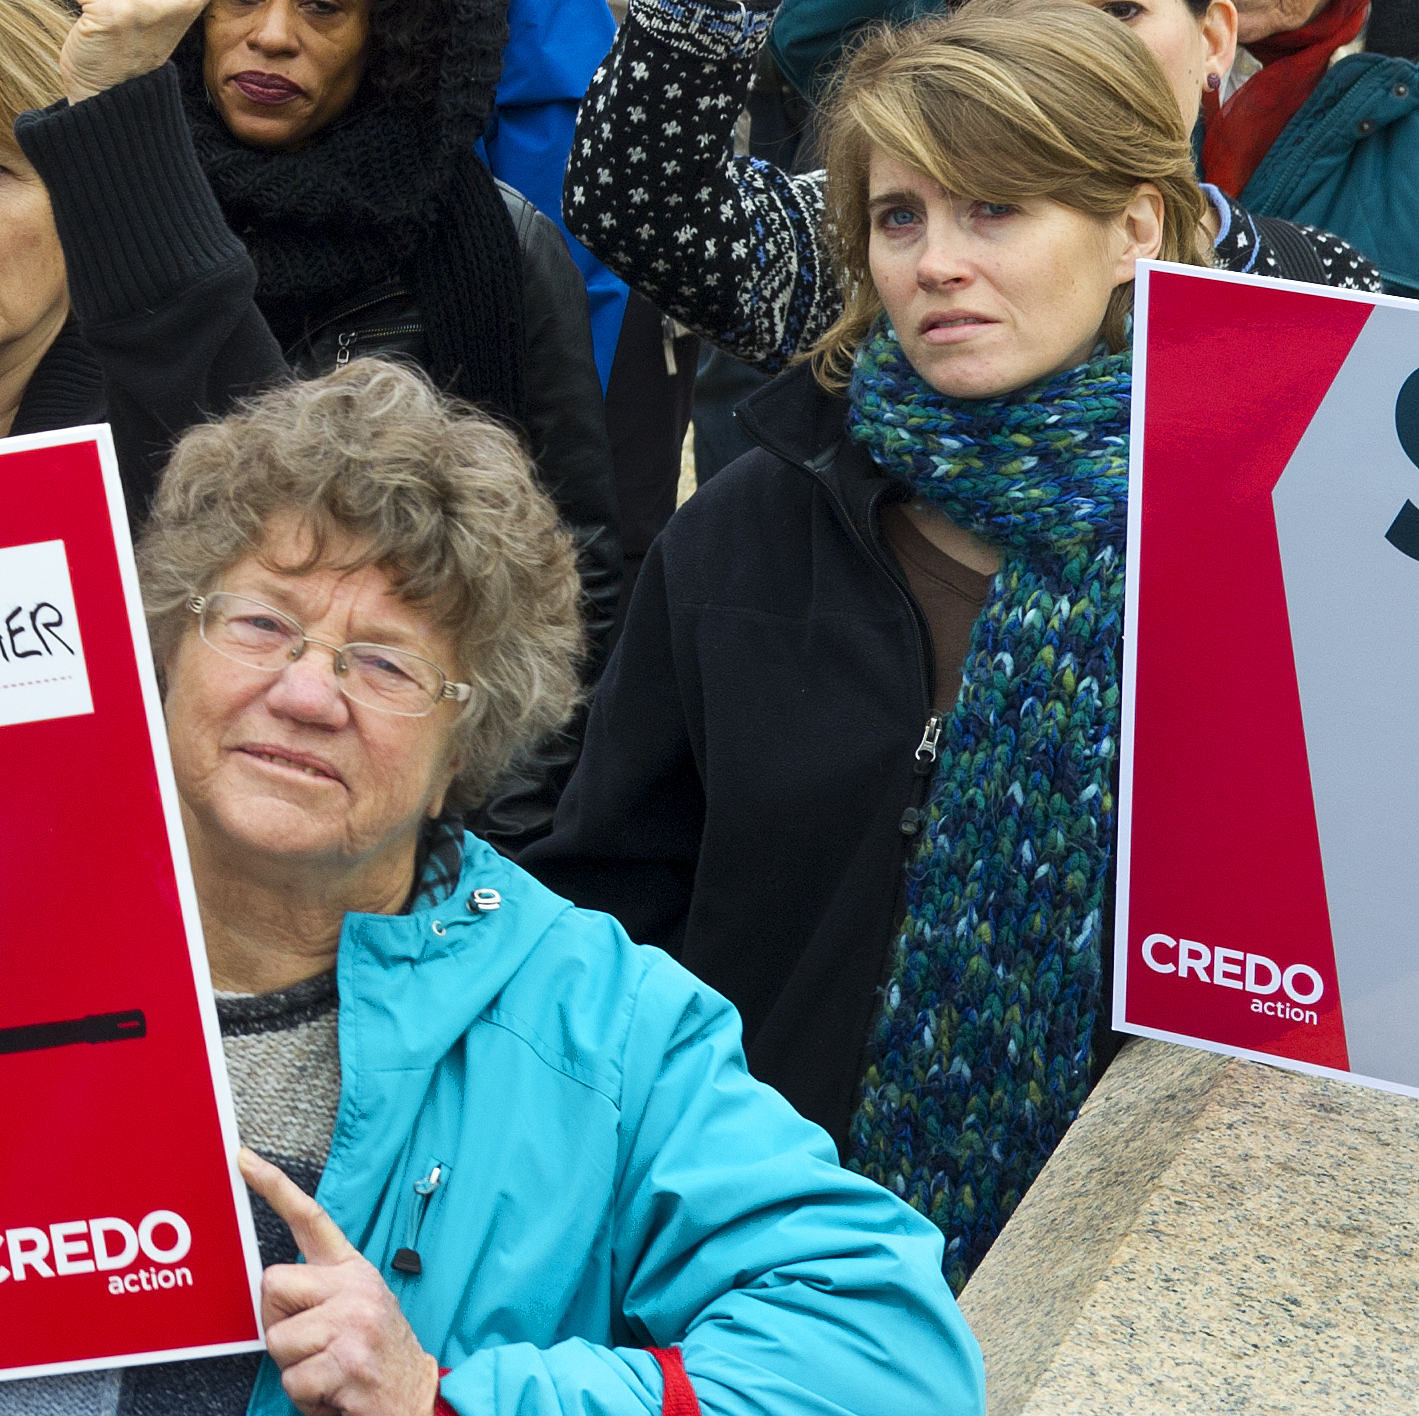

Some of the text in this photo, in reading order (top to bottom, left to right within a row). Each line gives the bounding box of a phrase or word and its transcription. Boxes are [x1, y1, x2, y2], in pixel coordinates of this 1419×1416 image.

[1142, 934, 1324, 1005] CREDO
[1250, 997, 1318, 1026] action
[107, 1261, 193, 1295] action
